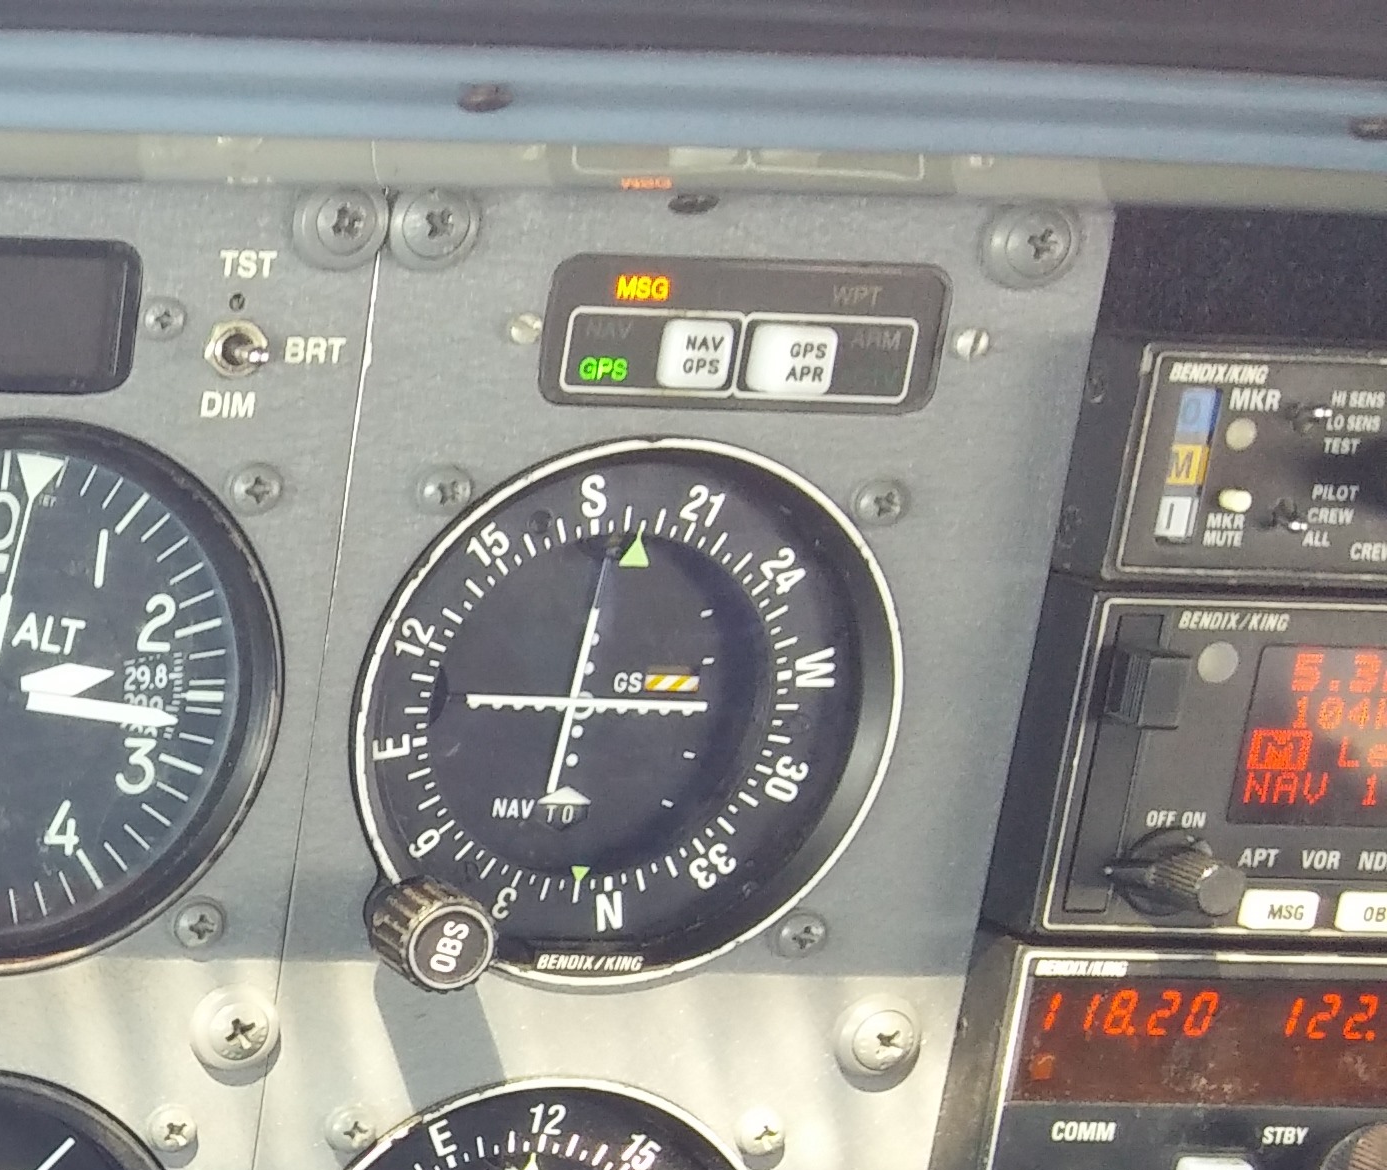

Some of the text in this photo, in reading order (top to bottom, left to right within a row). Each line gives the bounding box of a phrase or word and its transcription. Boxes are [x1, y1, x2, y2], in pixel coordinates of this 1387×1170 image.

[220, 250, 278, 278] TST
[615, 274, 670, 302] MSG
[284, 336, 346, 364] BRT
[685, 334, 725, 352] NAV
[789, 342, 827, 359] GPS
[579, 356, 629, 382] GPS
[682, 357, 720, 376] GPS
[785, 365, 825, 383] APR
[1169, 362, 1269, 385] BENDIX/KING
[200, 391, 256, 418] DIM
[1229, 388, 1282, 411] MKR
[12, 613, 87, 655] ALT
[123, 662, 170, 691] 29.8
[613, 672, 642, 693] GS
[492, 799, 535, 820] NAV
[430, 920, 469, 974] OBS
[536, 954, 645, 972] BENDIX/KING
[1042, 989, 1220, 1038] 118.20
[1051, 1121, 1117, 1143] COMM
[1262, 1126, 1310, 1147] STBY
